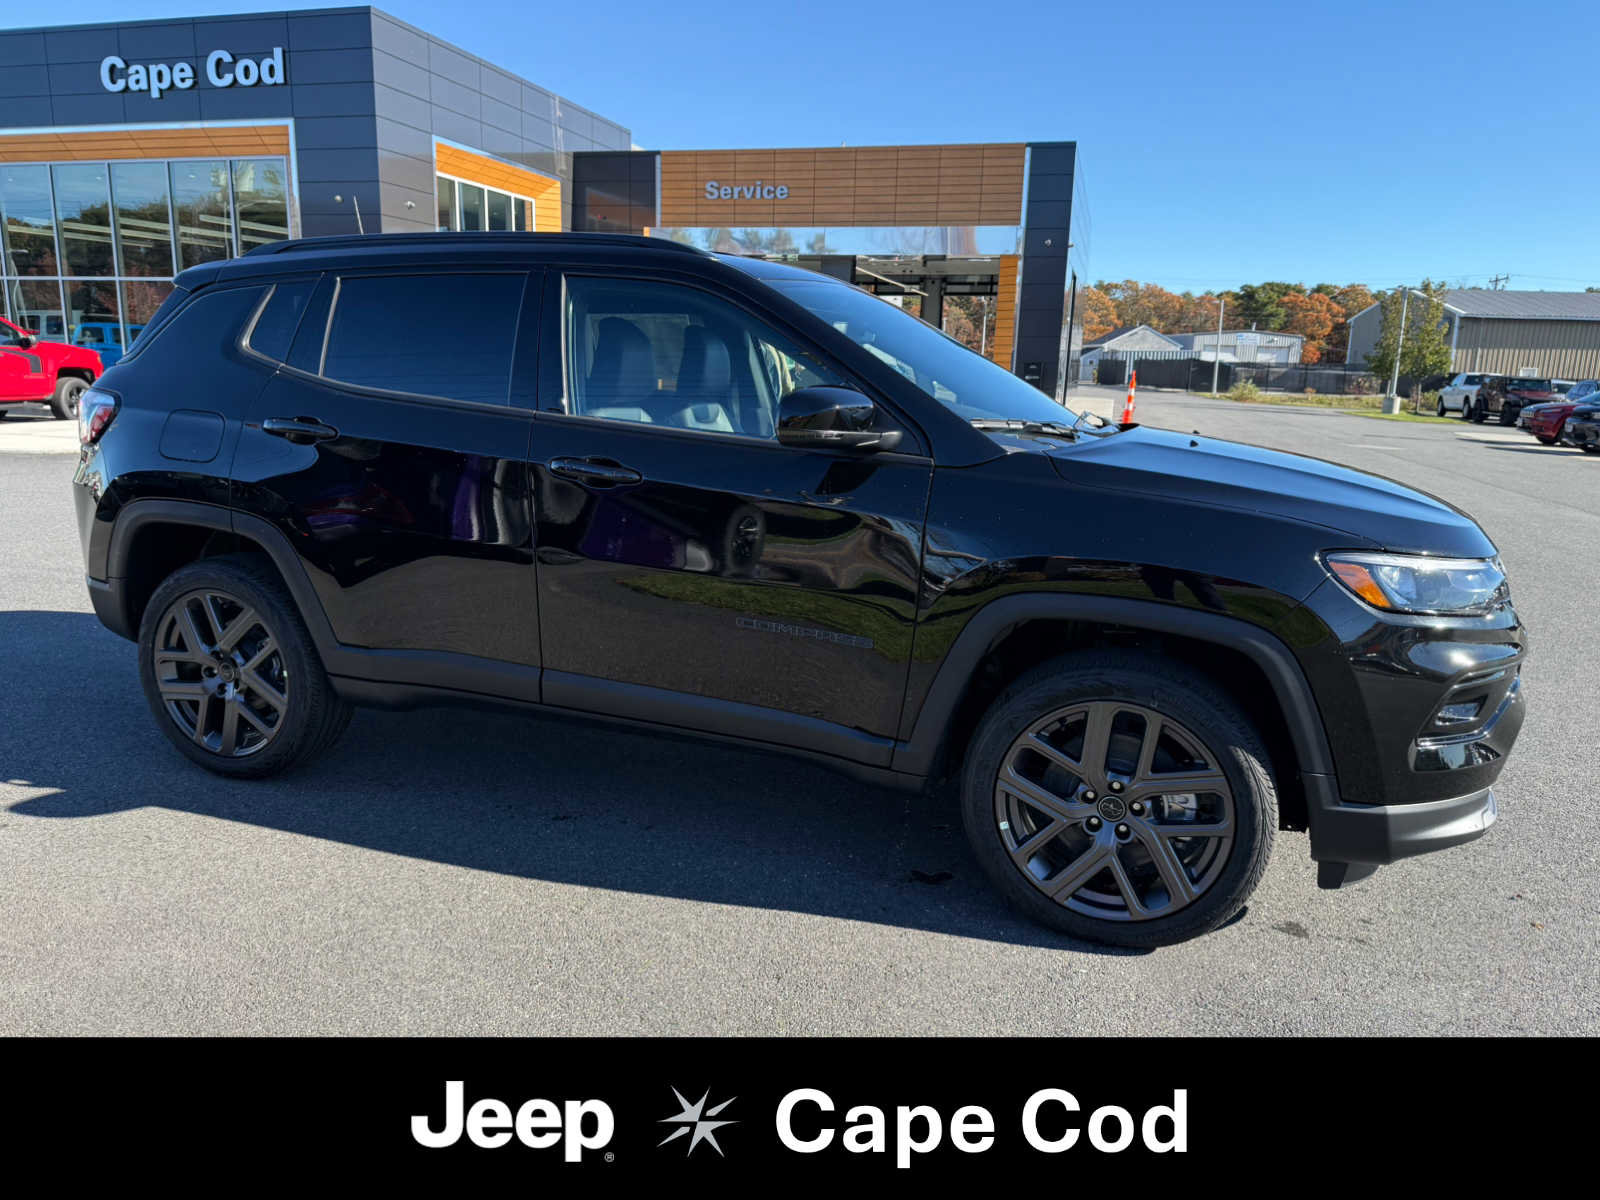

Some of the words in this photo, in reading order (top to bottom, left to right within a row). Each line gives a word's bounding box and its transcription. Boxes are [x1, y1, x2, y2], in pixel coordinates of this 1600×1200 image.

[100, 55, 196, 99] Cape
[206, 47, 286, 88] Cod
[704, 180, 789, 200] Service
